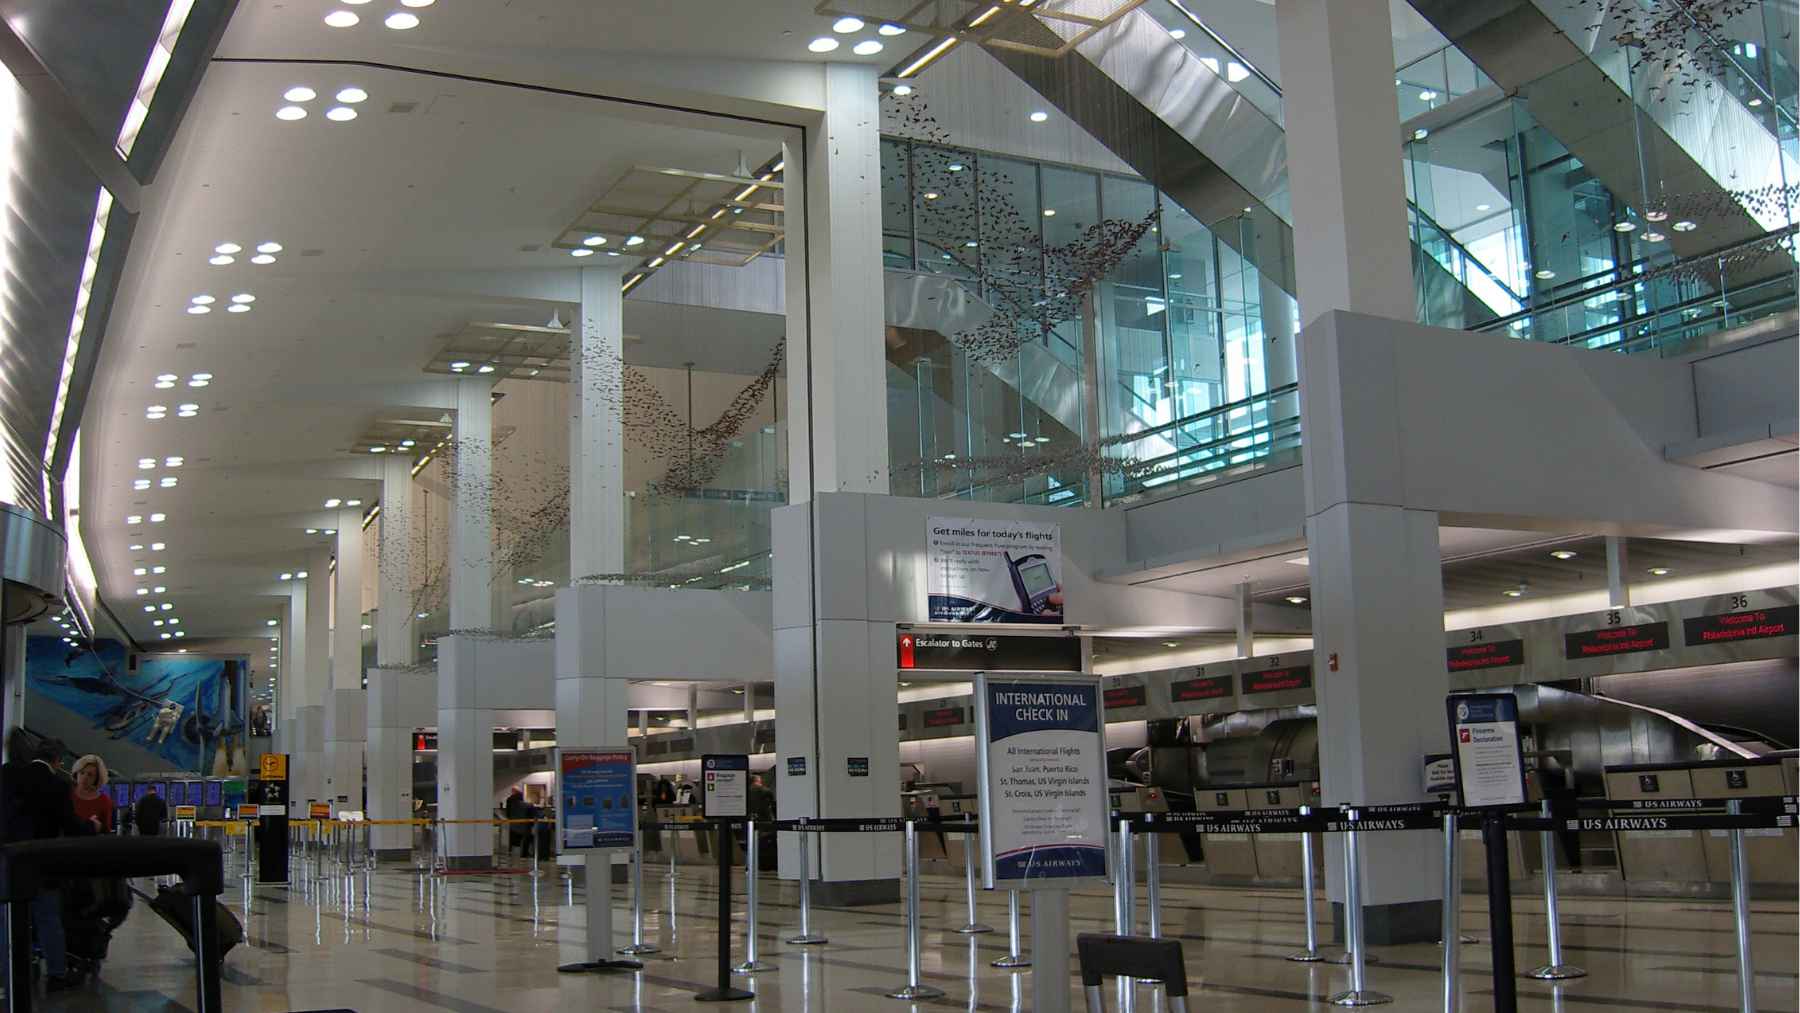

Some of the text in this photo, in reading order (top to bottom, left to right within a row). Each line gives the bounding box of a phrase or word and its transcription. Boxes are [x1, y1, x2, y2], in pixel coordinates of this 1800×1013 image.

[933, 527, 1053, 541] Get miles for today's flights
[1731, 595, 1748, 609] 36
[1607, 612, 1621, 625] 35
[1470, 631, 1483, 642] 34
[915, 638, 984, 649] Escalator to Gates
[995, 692, 1087, 706] INTERNATIONAL
[1015, 708, 1069, 721] CHECK IN
[1007, 747, 1080, 757] All International Flights
[1011, 765, 1023, 773] San
[1043, 765, 1064, 773] Puerto
[1065, 765, 1079, 773] Rico
[1000, 777, 1090, 787] St. Thomas, US Virgin Islands
[1004, 789, 1087, 800] St. Croix, US Virgin Islands
[1660, 799, 1703, 809] AIRWAYS
[1221, 824, 1262, 833] AIRWAYS
[1356, 819, 1405, 831] AIRWAYS
[1604, 818, 1668, 830] AIRWAYS
[1044, 859, 1081, 867] AIRWAYS
